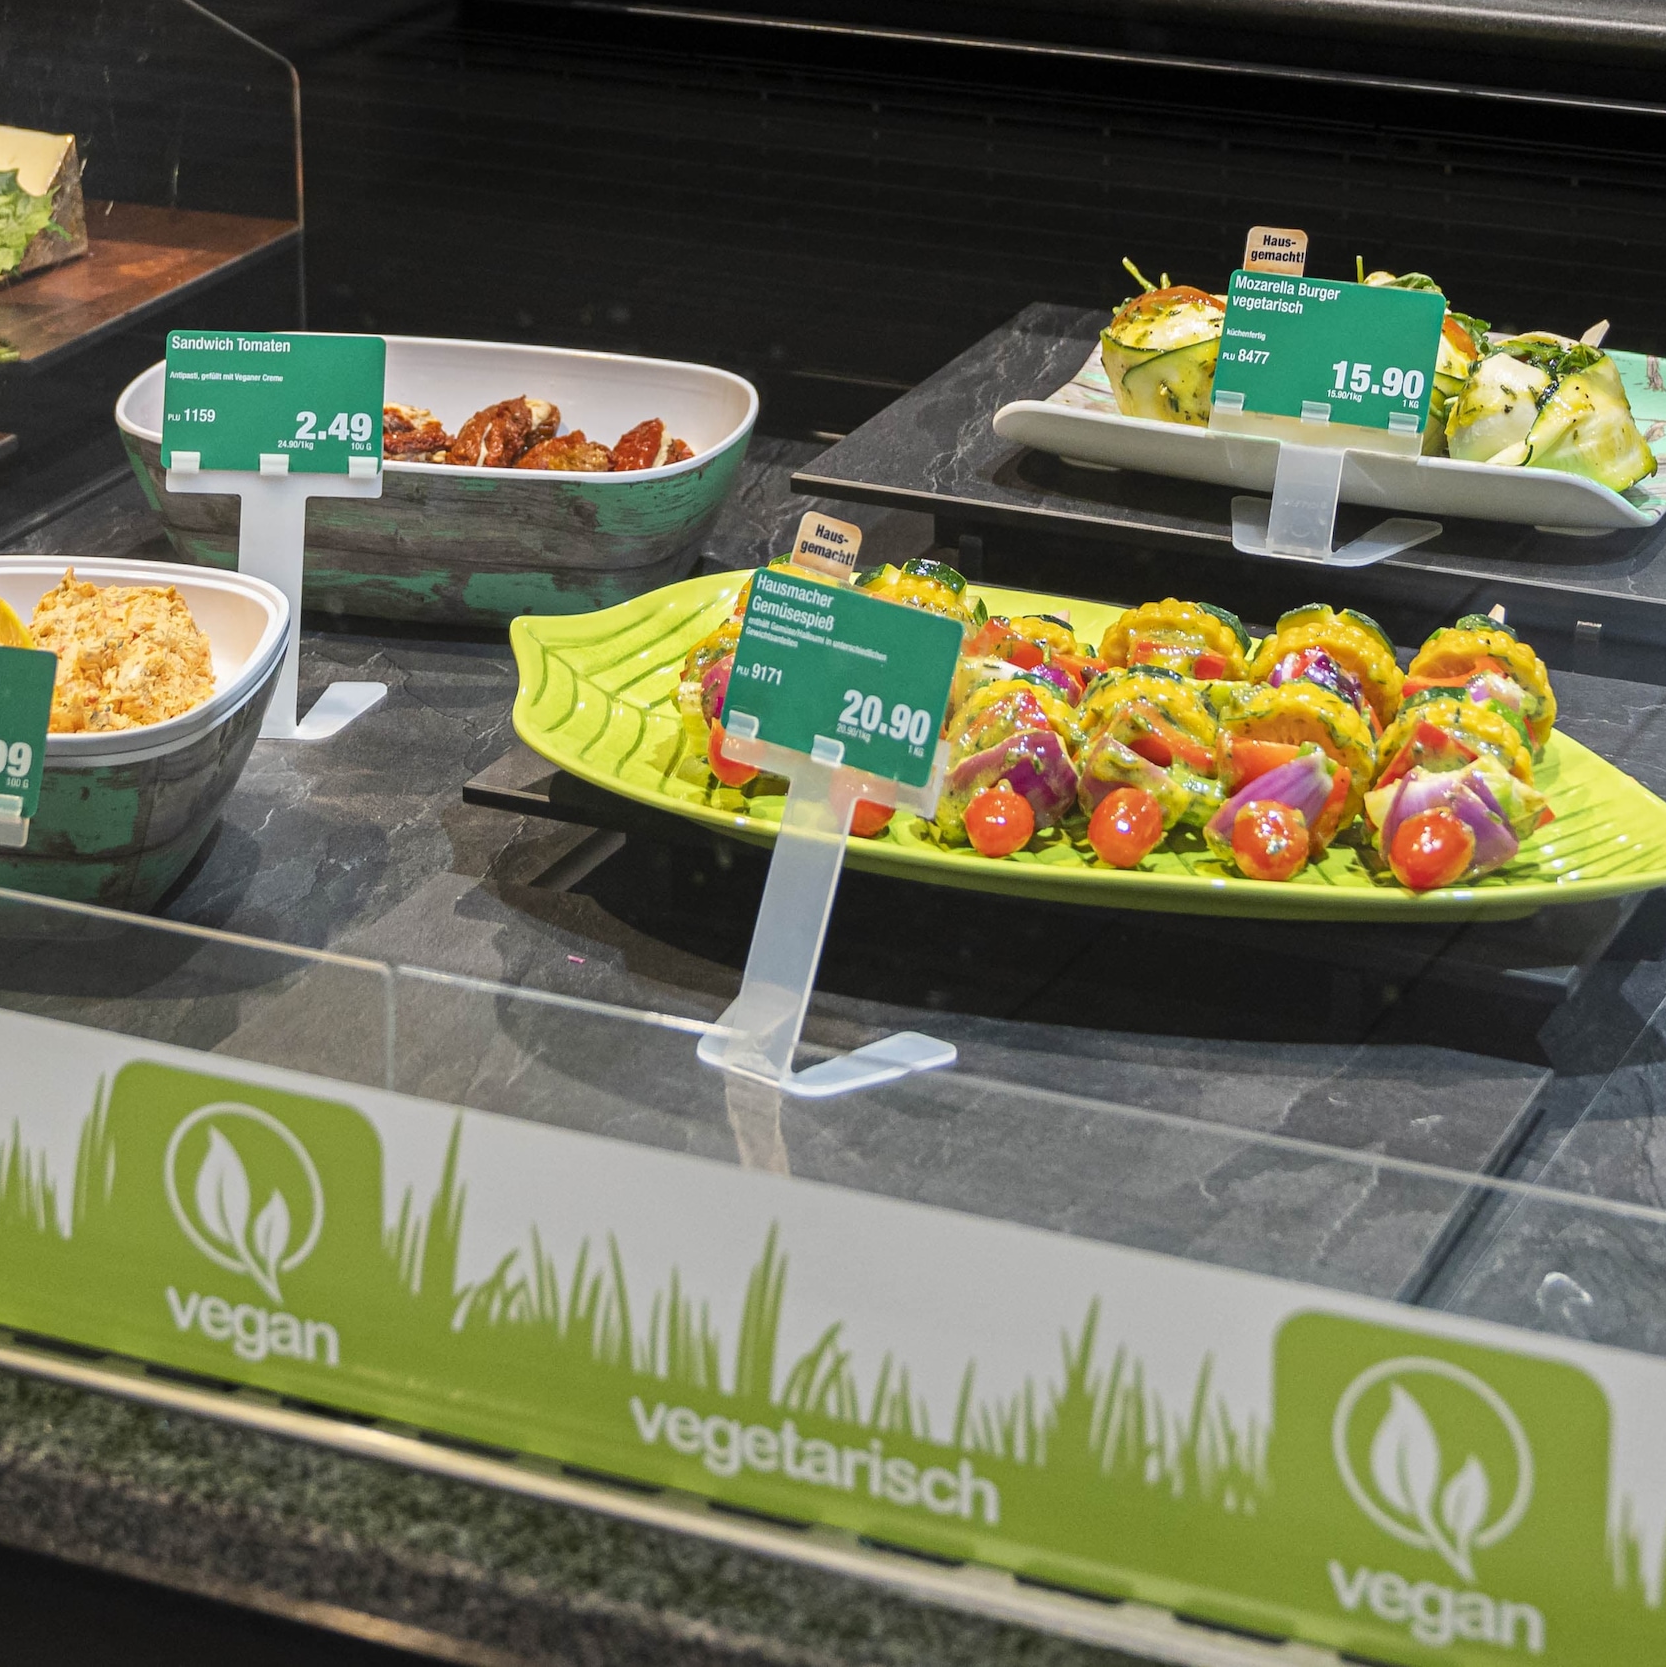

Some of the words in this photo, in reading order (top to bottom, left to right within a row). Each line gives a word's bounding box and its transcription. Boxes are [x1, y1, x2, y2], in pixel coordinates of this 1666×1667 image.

[1262, 234, 1297, 248] Haus-
[1251, 249, 1305, 264] gemacht!
[1235, 275, 1295, 296] Mozarella
[1298, 282, 1341, 301] Burger
[1232, 295, 1304, 315] vegetarisch
[171, 335, 234, 351] Sandwich
[236, 337, 291, 353] Tomaten
[1226, 327, 1267, 341] küchenfertig
[1222, 352, 1236, 361] PLU
[1238, 348, 1270, 365] 8477
[169, 370, 200, 381] Antipasti,
[201, 371, 222, 381] gefüllt
[222, 372, 234, 380] mit
[234, 373, 261, 382] Veganer
[262, 374, 284, 382] Creme
[1332, 360, 1425, 400] 15.90
[1327, 389, 1363, 403] 15.90/1kg
[1408, 400, 1420, 409] KG
[167, 413, 181, 422] PLU
[183, 408, 216, 423] 1159
[295, 411, 373, 442] 2.49
[277, 440, 314, 451] 24.90/1kg
[351, 442, 364, 451] 100
[365, 443, 372, 451] G
[815, 523, 849, 545] Haus-
[800, 540, 855, 567] gemacht!
[756, 574, 834, 608] Hausmacher
[751, 596, 835, 632] Gemüsespieß
[736, 665, 749, 676] PLU
[751, 662, 783, 686] 9171
[839, 689, 931, 746] 20.90
[6, 777, 21, 788] 100
[21, 778, 29, 789] G
[164, 1286, 340, 1366] vegan
[630, 1395, 1002, 1527] vegetarisch
[1328, 1560, 1546, 1655] vegan
